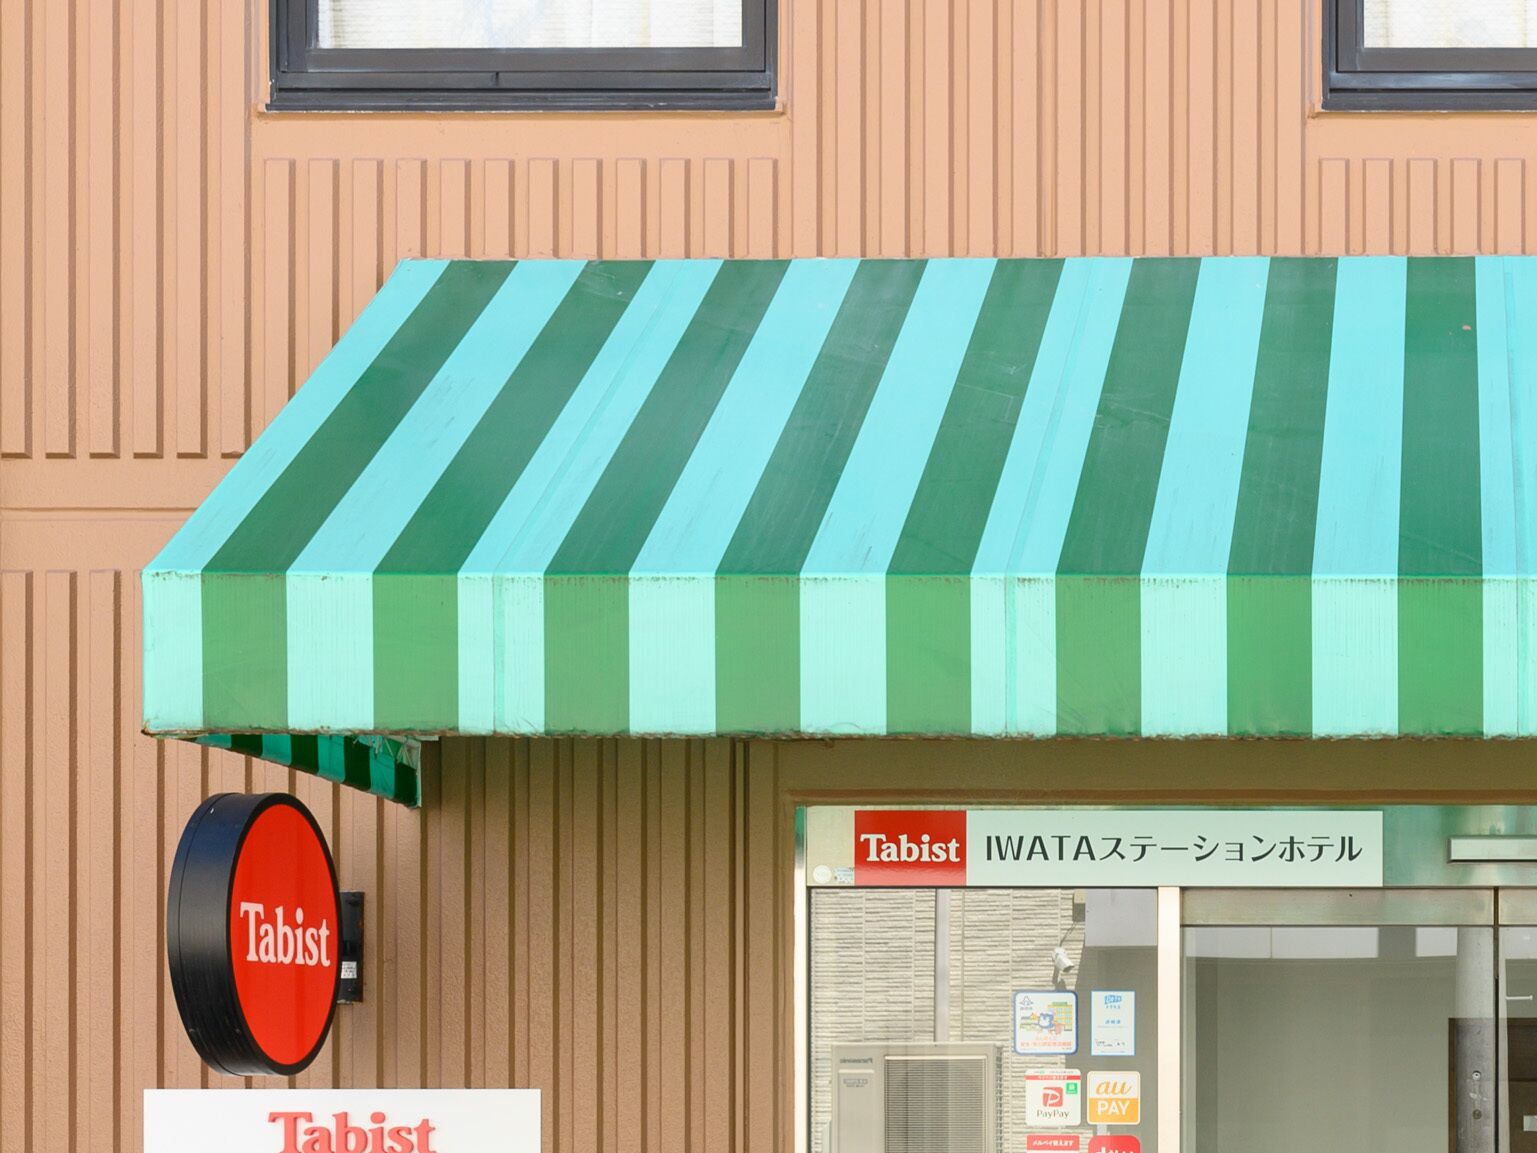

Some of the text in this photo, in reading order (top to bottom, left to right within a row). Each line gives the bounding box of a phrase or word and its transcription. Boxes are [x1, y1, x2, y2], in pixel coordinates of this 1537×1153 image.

[859, 833, 1363, 864] Tabist IWATAステーションホテル
[239, 901, 331, 968] Tabist
[1095, 1079, 1132, 1095] au
[1036, 1109, 1070, 1119] PayPay
[1097, 1100, 1131, 1116] PAY
